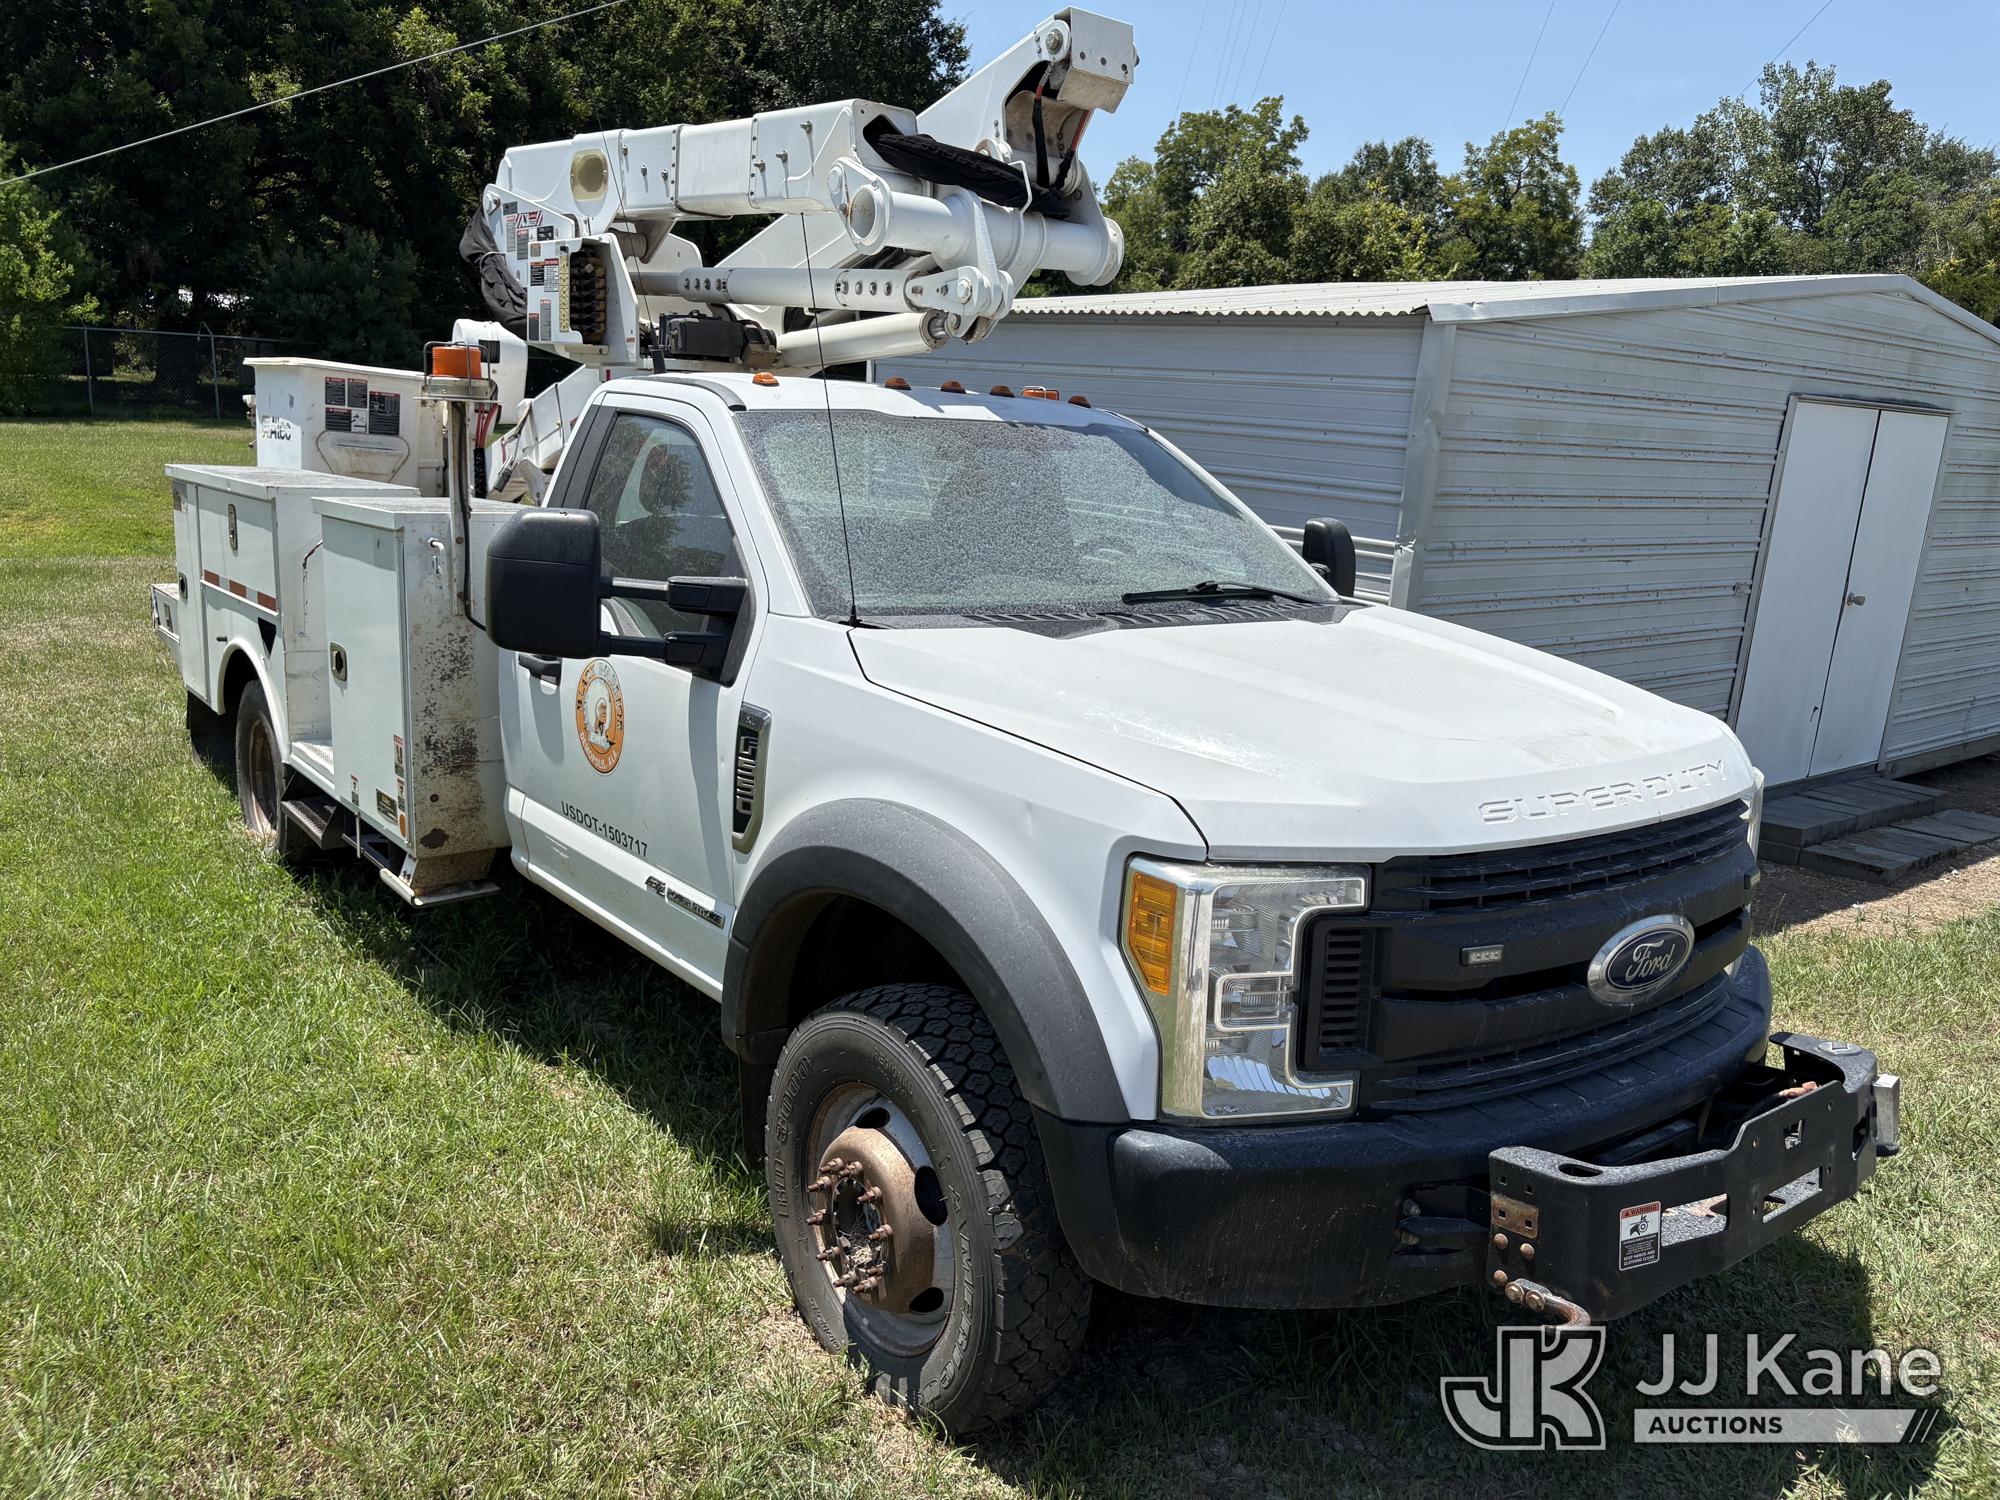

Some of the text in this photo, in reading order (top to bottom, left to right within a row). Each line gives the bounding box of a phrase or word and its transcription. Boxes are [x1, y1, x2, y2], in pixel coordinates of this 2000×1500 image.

[1478, 760, 1728, 825] SUPER DUTY
[561, 800, 648, 857] USDOT-1503717
[1625, 939, 1676, 983] Ford
[1631, 1204, 1657, 1215] WARNING
